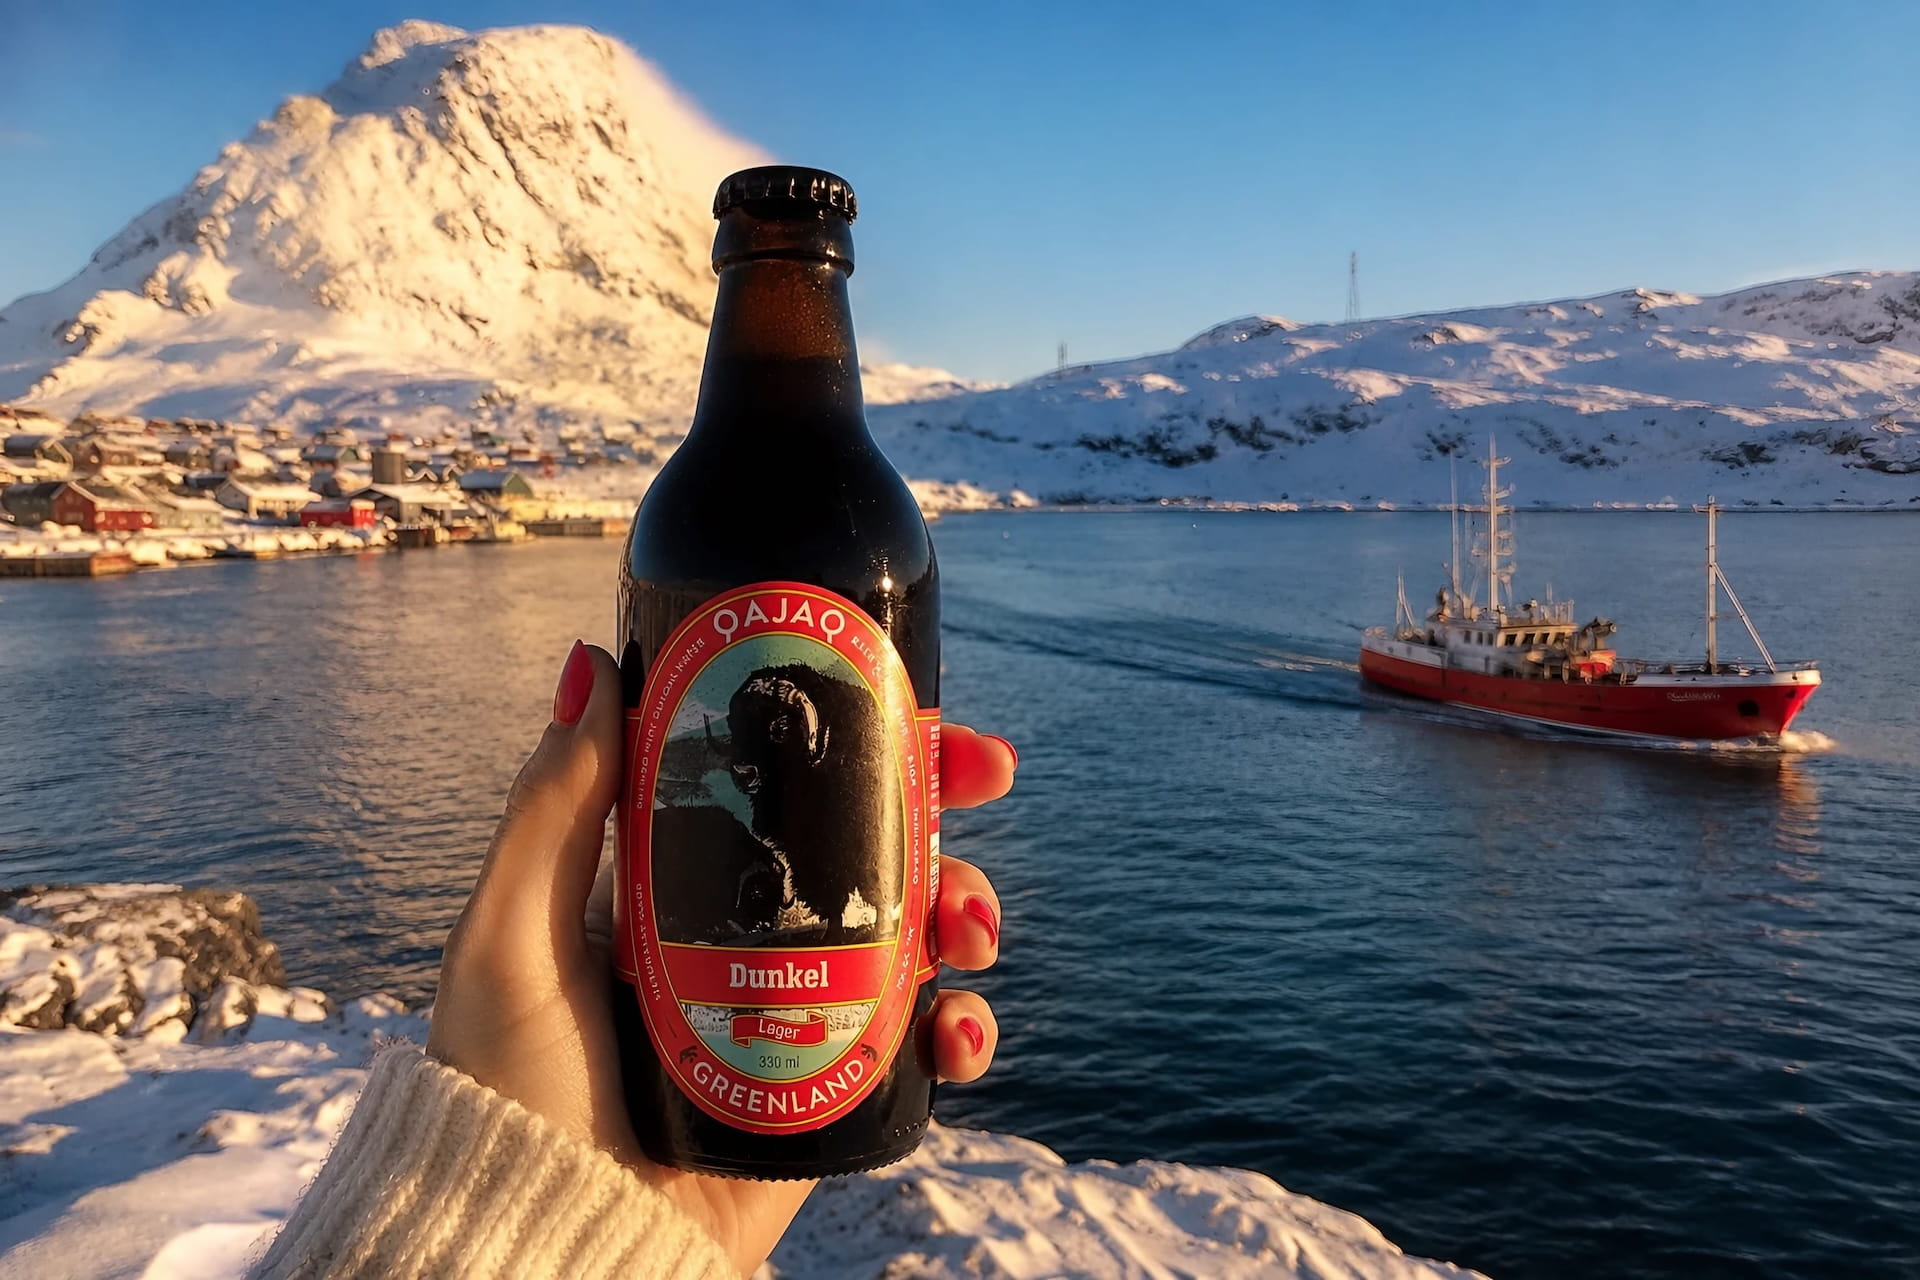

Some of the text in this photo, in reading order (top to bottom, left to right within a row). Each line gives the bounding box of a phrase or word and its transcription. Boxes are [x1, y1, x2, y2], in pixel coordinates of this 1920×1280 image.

[714, 598, 845, 644] QAJAQ
[730, 961, 829, 988] Dunkel
[759, 1019, 800, 1040] Lager
[759, 1055, 800, 1069] 330 ml
[693, 1059, 864, 1115] GREENLAND
